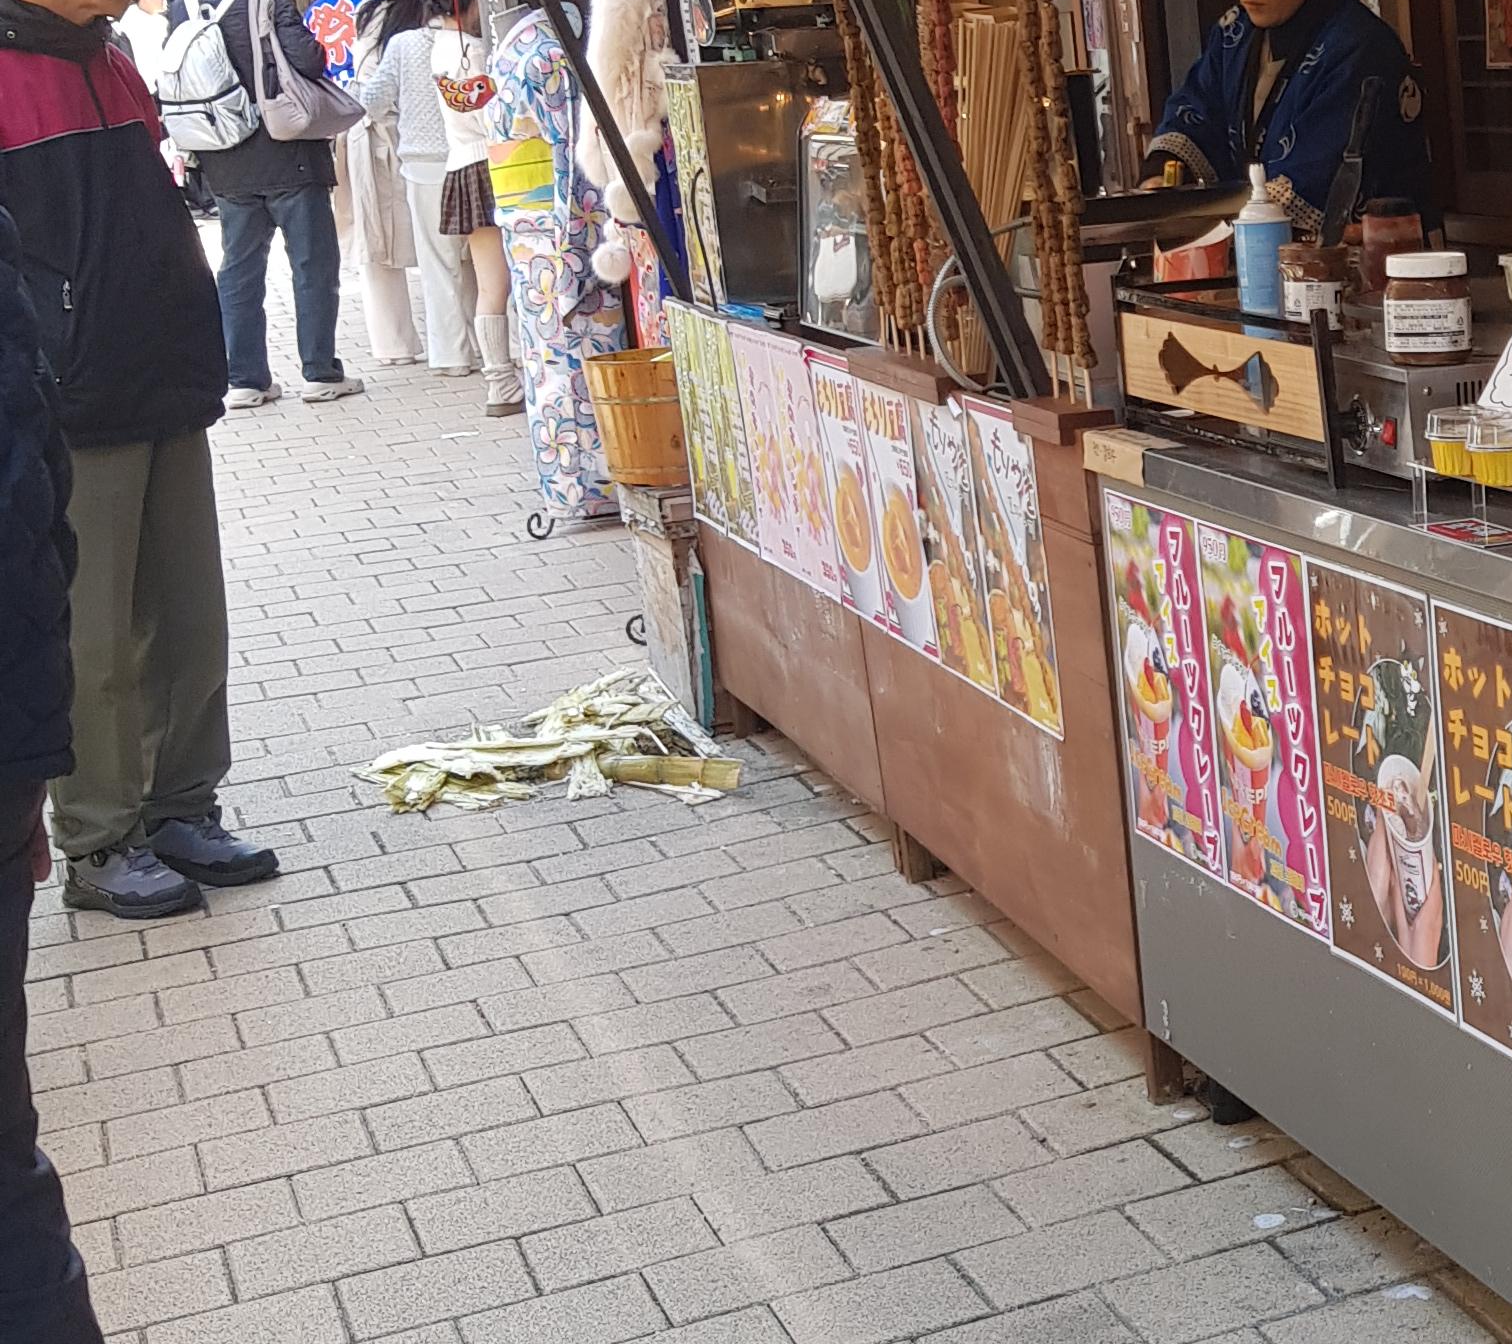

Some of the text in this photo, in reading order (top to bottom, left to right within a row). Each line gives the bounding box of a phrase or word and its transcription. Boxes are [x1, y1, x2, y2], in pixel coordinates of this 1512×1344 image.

[1153, 560, 1180, 668] アイス
[1315, 599, 1372, 654] ホット
[1251, 596, 1282, 712] アイス
[1318, 656, 1376, 710] チョコ
[1443, 647, 1511, 708] ホット
[1167, 527, 1220, 871] フルーツクレープ
[1268, 561, 1327, 931] フルーツクレープ
[1324, 709, 1380, 767] レート
[1327, 796, 1358, 829] 500円
[1455, 859, 1491, 897] 500円
